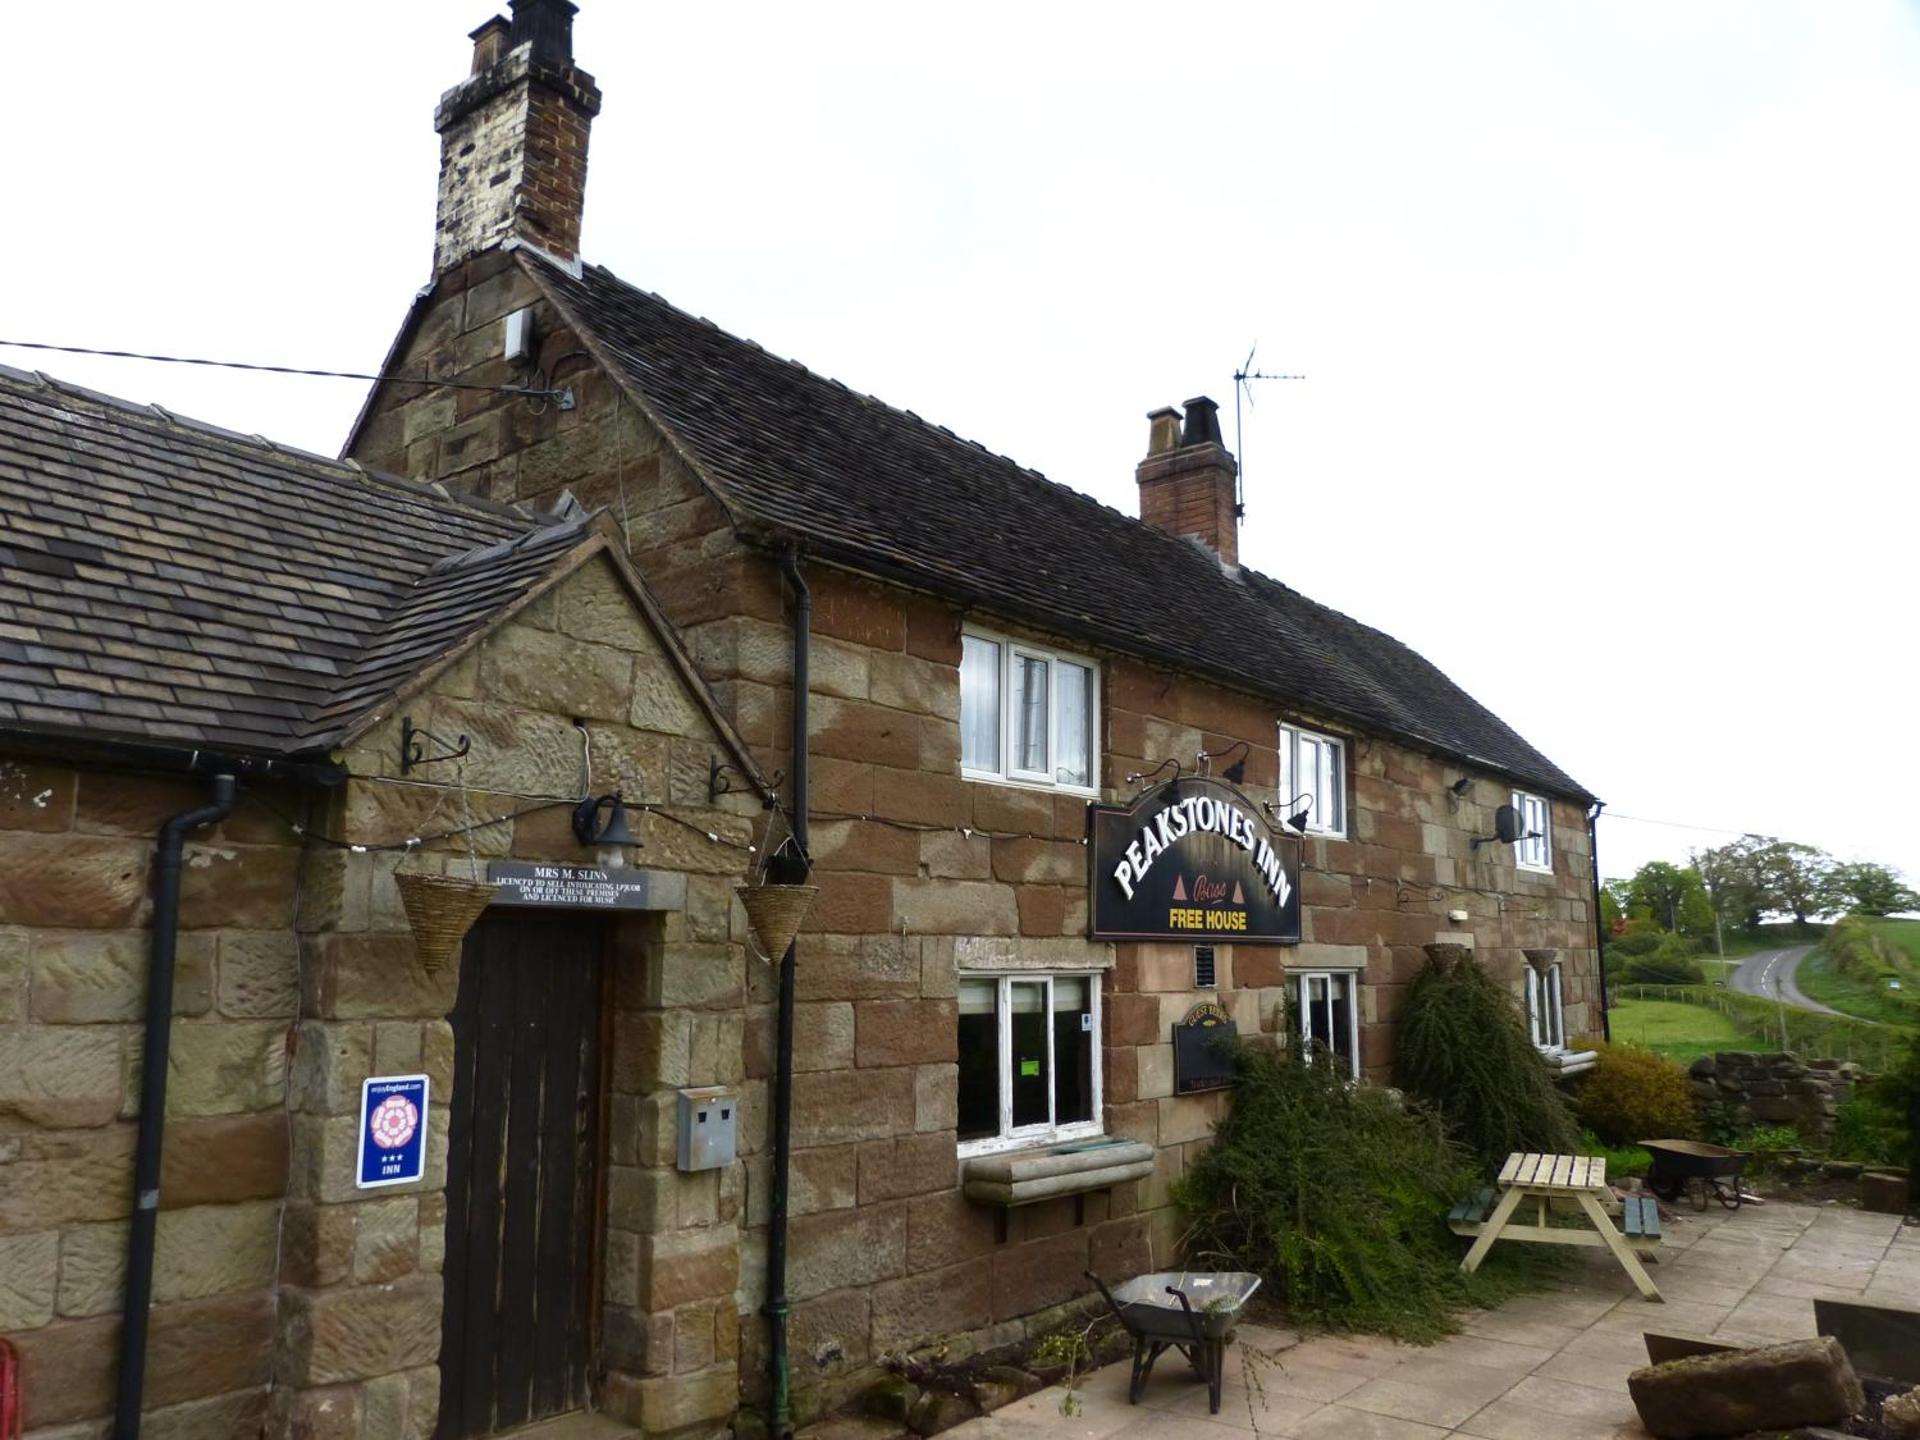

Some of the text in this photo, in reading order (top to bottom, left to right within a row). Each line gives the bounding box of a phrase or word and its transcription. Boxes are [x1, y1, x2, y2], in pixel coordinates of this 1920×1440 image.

[1114, 796, 1292, 909] PEAKSTONES INN
[534, 867, 559, 878] MRS
[535, 879, 546, 887] TO
[547, 880, 565, 888] SELL
[1169, 908, 1247, 930] FREE HOUSE
[382, 1164, 401, 1175] INN
